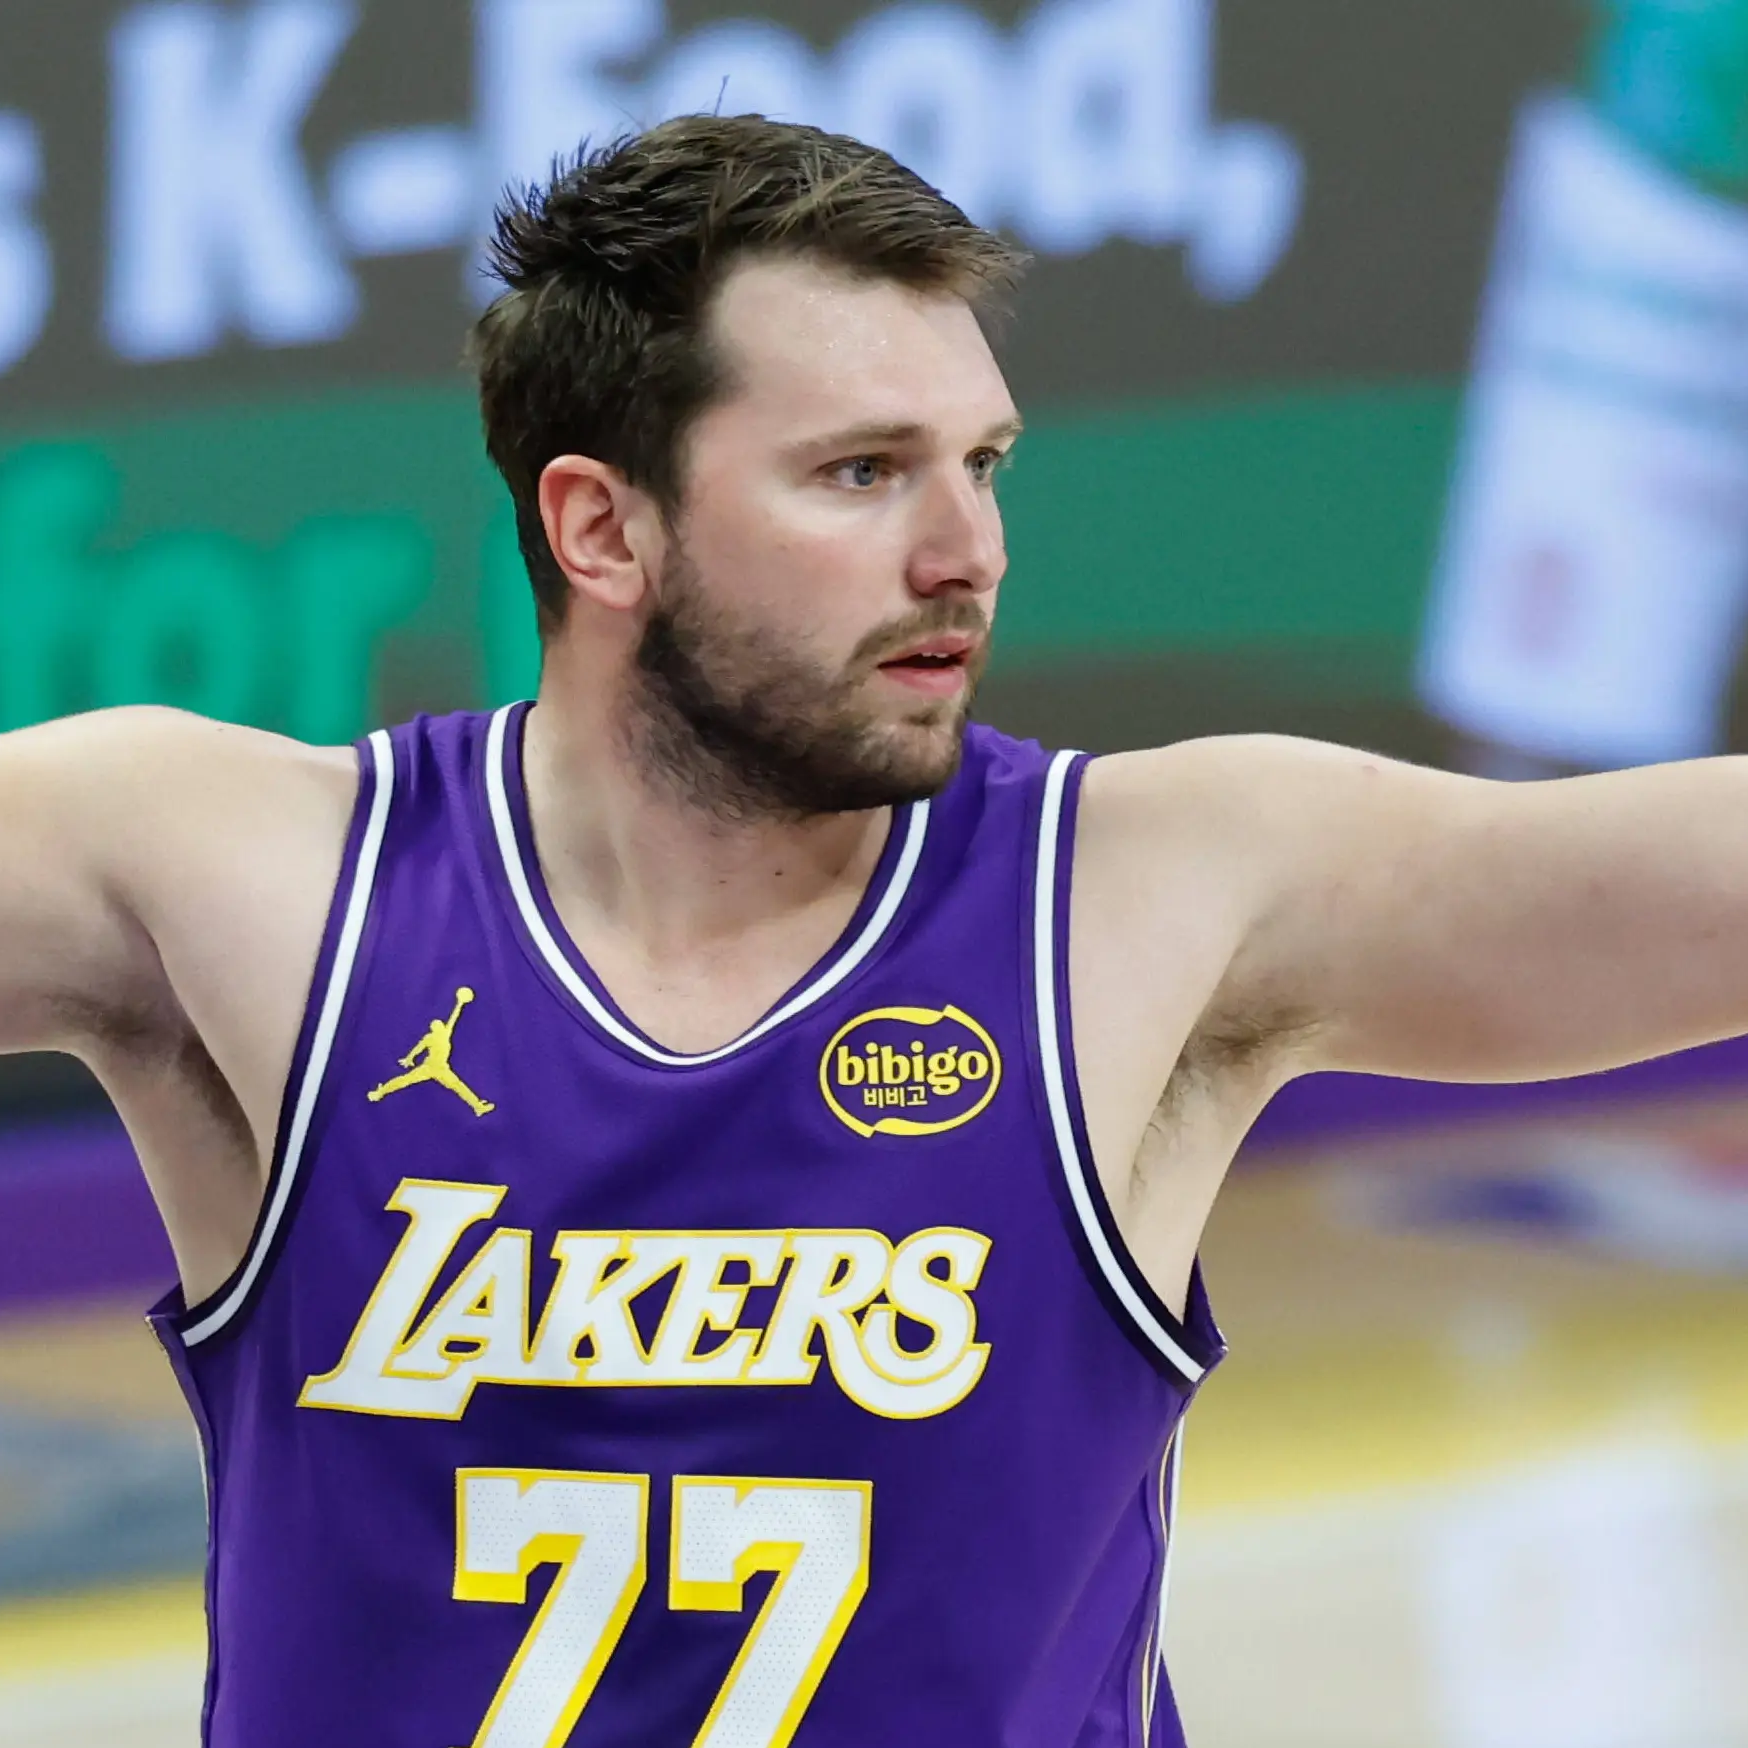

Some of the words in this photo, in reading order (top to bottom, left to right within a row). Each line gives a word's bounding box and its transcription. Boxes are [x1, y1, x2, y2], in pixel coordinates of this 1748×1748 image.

[837, 1040, 989, 1096] bibigo
[863, 1086, 929, 1109] 비비고
[296, 1177, 992, 1420] LAKERS
